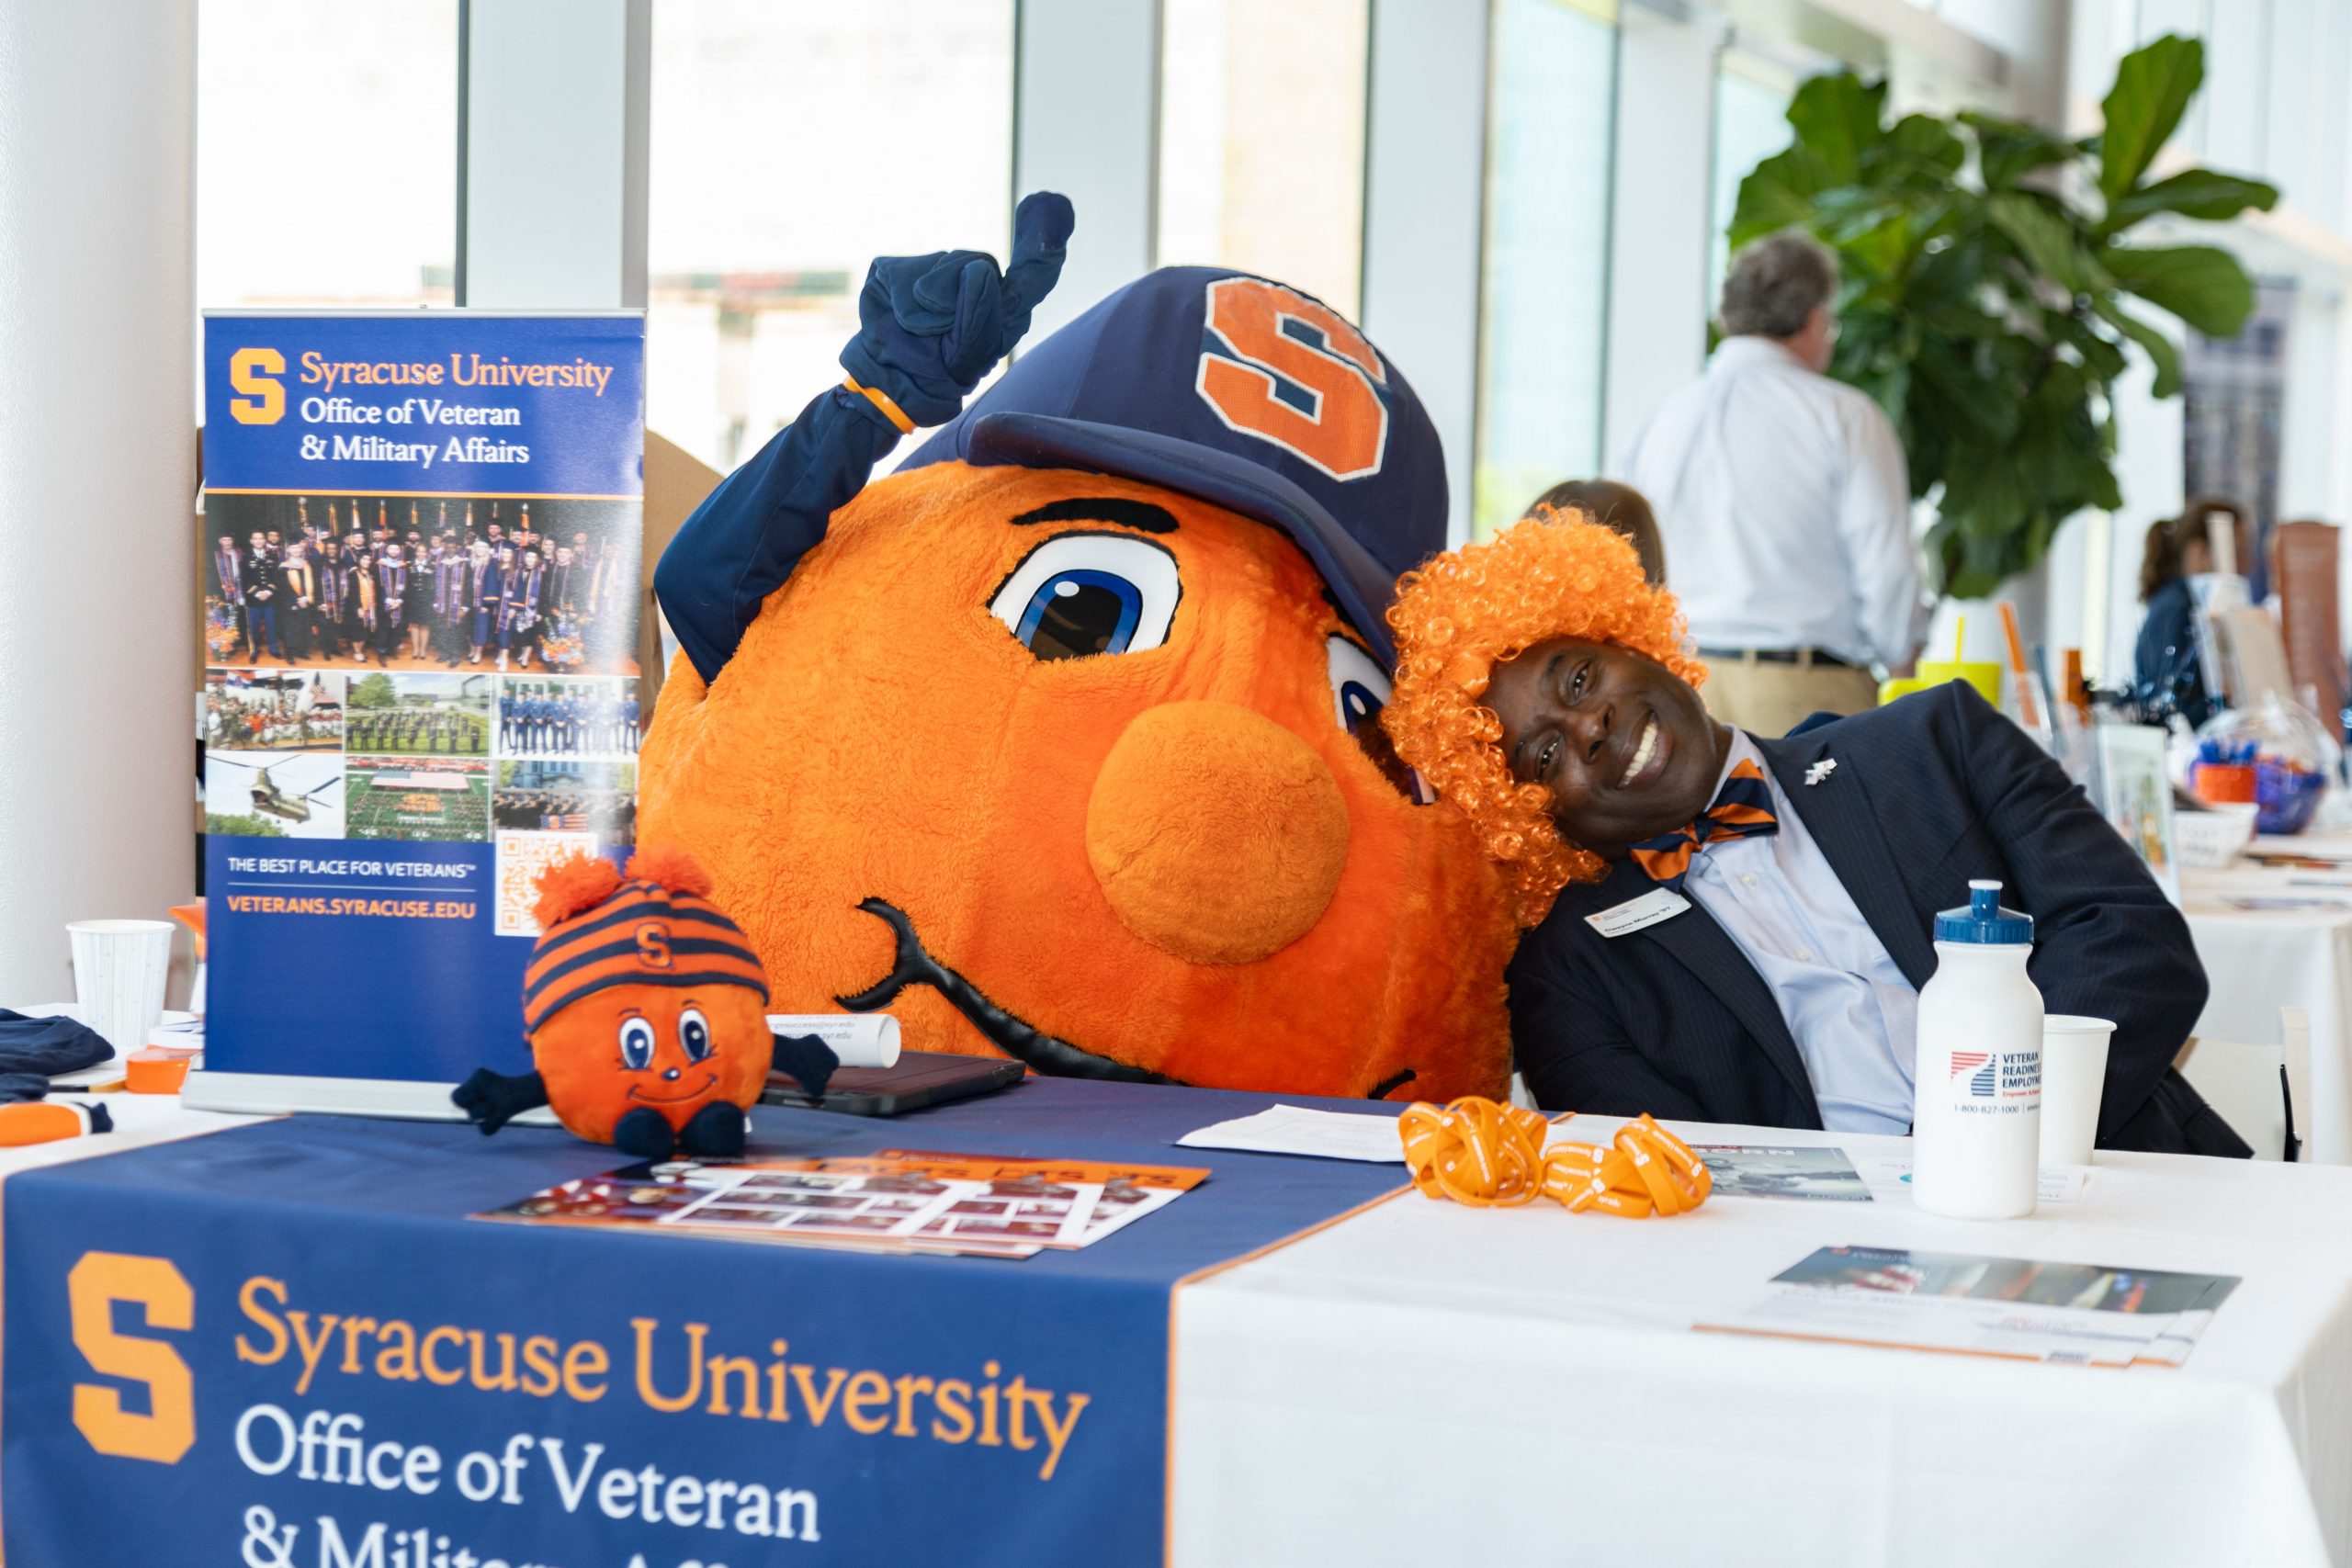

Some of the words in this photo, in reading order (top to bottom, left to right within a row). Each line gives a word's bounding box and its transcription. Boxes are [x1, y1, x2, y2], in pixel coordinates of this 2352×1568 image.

[231, 348, 286, 424] S
[300, 351, 444, 392] Syracuse
[451, 354, 613, 396] University
[1196, 277, 1388, 482] S
[300, 397, 381, 423] Office
[386, 397, 414, 423] of
[418, 399, 521, 426] Veteran
[300, 434, 326, 460] &
[334, 436, 437, 468] Military
[442, 438, 529, 463] Affairs
[228, 857, 255, 873] THE
[260, 858, 297, 874] BEST
[300, 860, 347, 875] PLACE
[350, 862, 382, 875] FOR
[227, 896, 476, 919] VETERANS.SYRACUSE.EDU
[635, 922, 674, 968] S
[2003, 1051, 2039, 1065] VETERAN
[68, 1251, 196, 1464] S
[235, 1276, 610, 1402] Syracuse
[630, 1317, 1091, 1481] University
[235, 1404, 443, 1495] Office
[456, 1433, 534, 1504] of
[540, 1438, 821, 1542] Veteran
[241, 1505, 300, 1568] &
